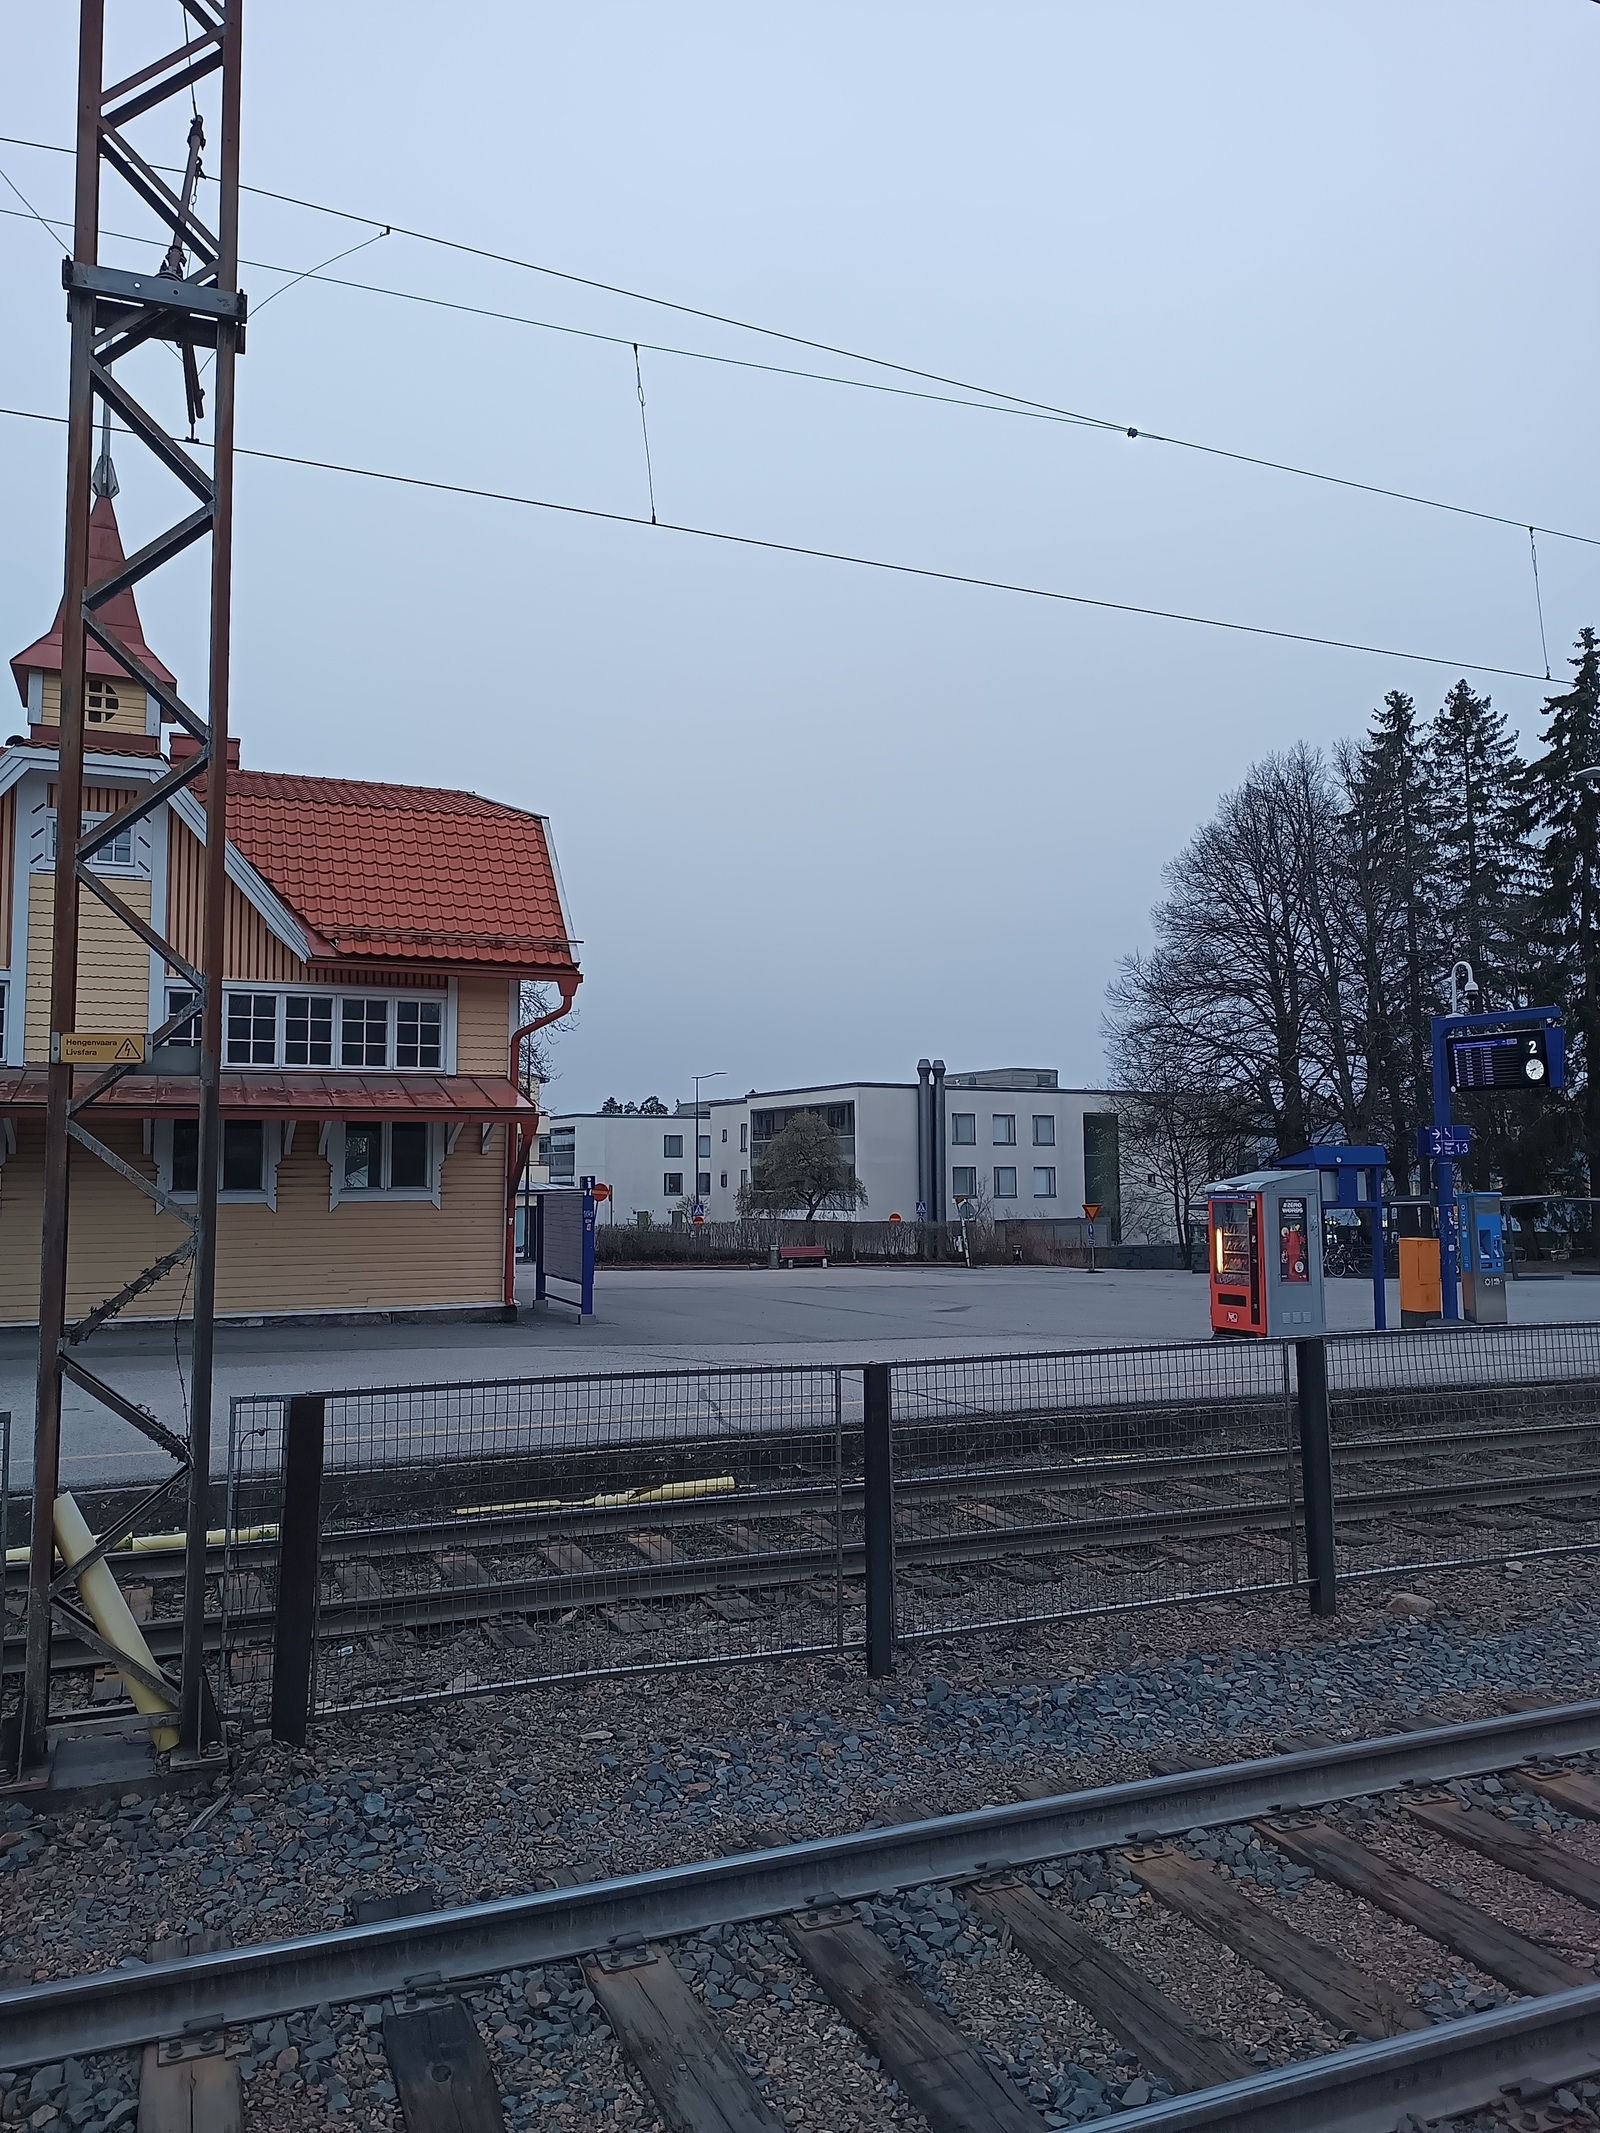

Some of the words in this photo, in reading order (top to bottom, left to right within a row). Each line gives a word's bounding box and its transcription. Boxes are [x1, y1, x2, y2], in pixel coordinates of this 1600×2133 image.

[66, 1039, 117, 1047] Hengenvaara
[1528, 1041, 1537, 1054] 2
[1455, 1142, 1469, 1154] 1,3
